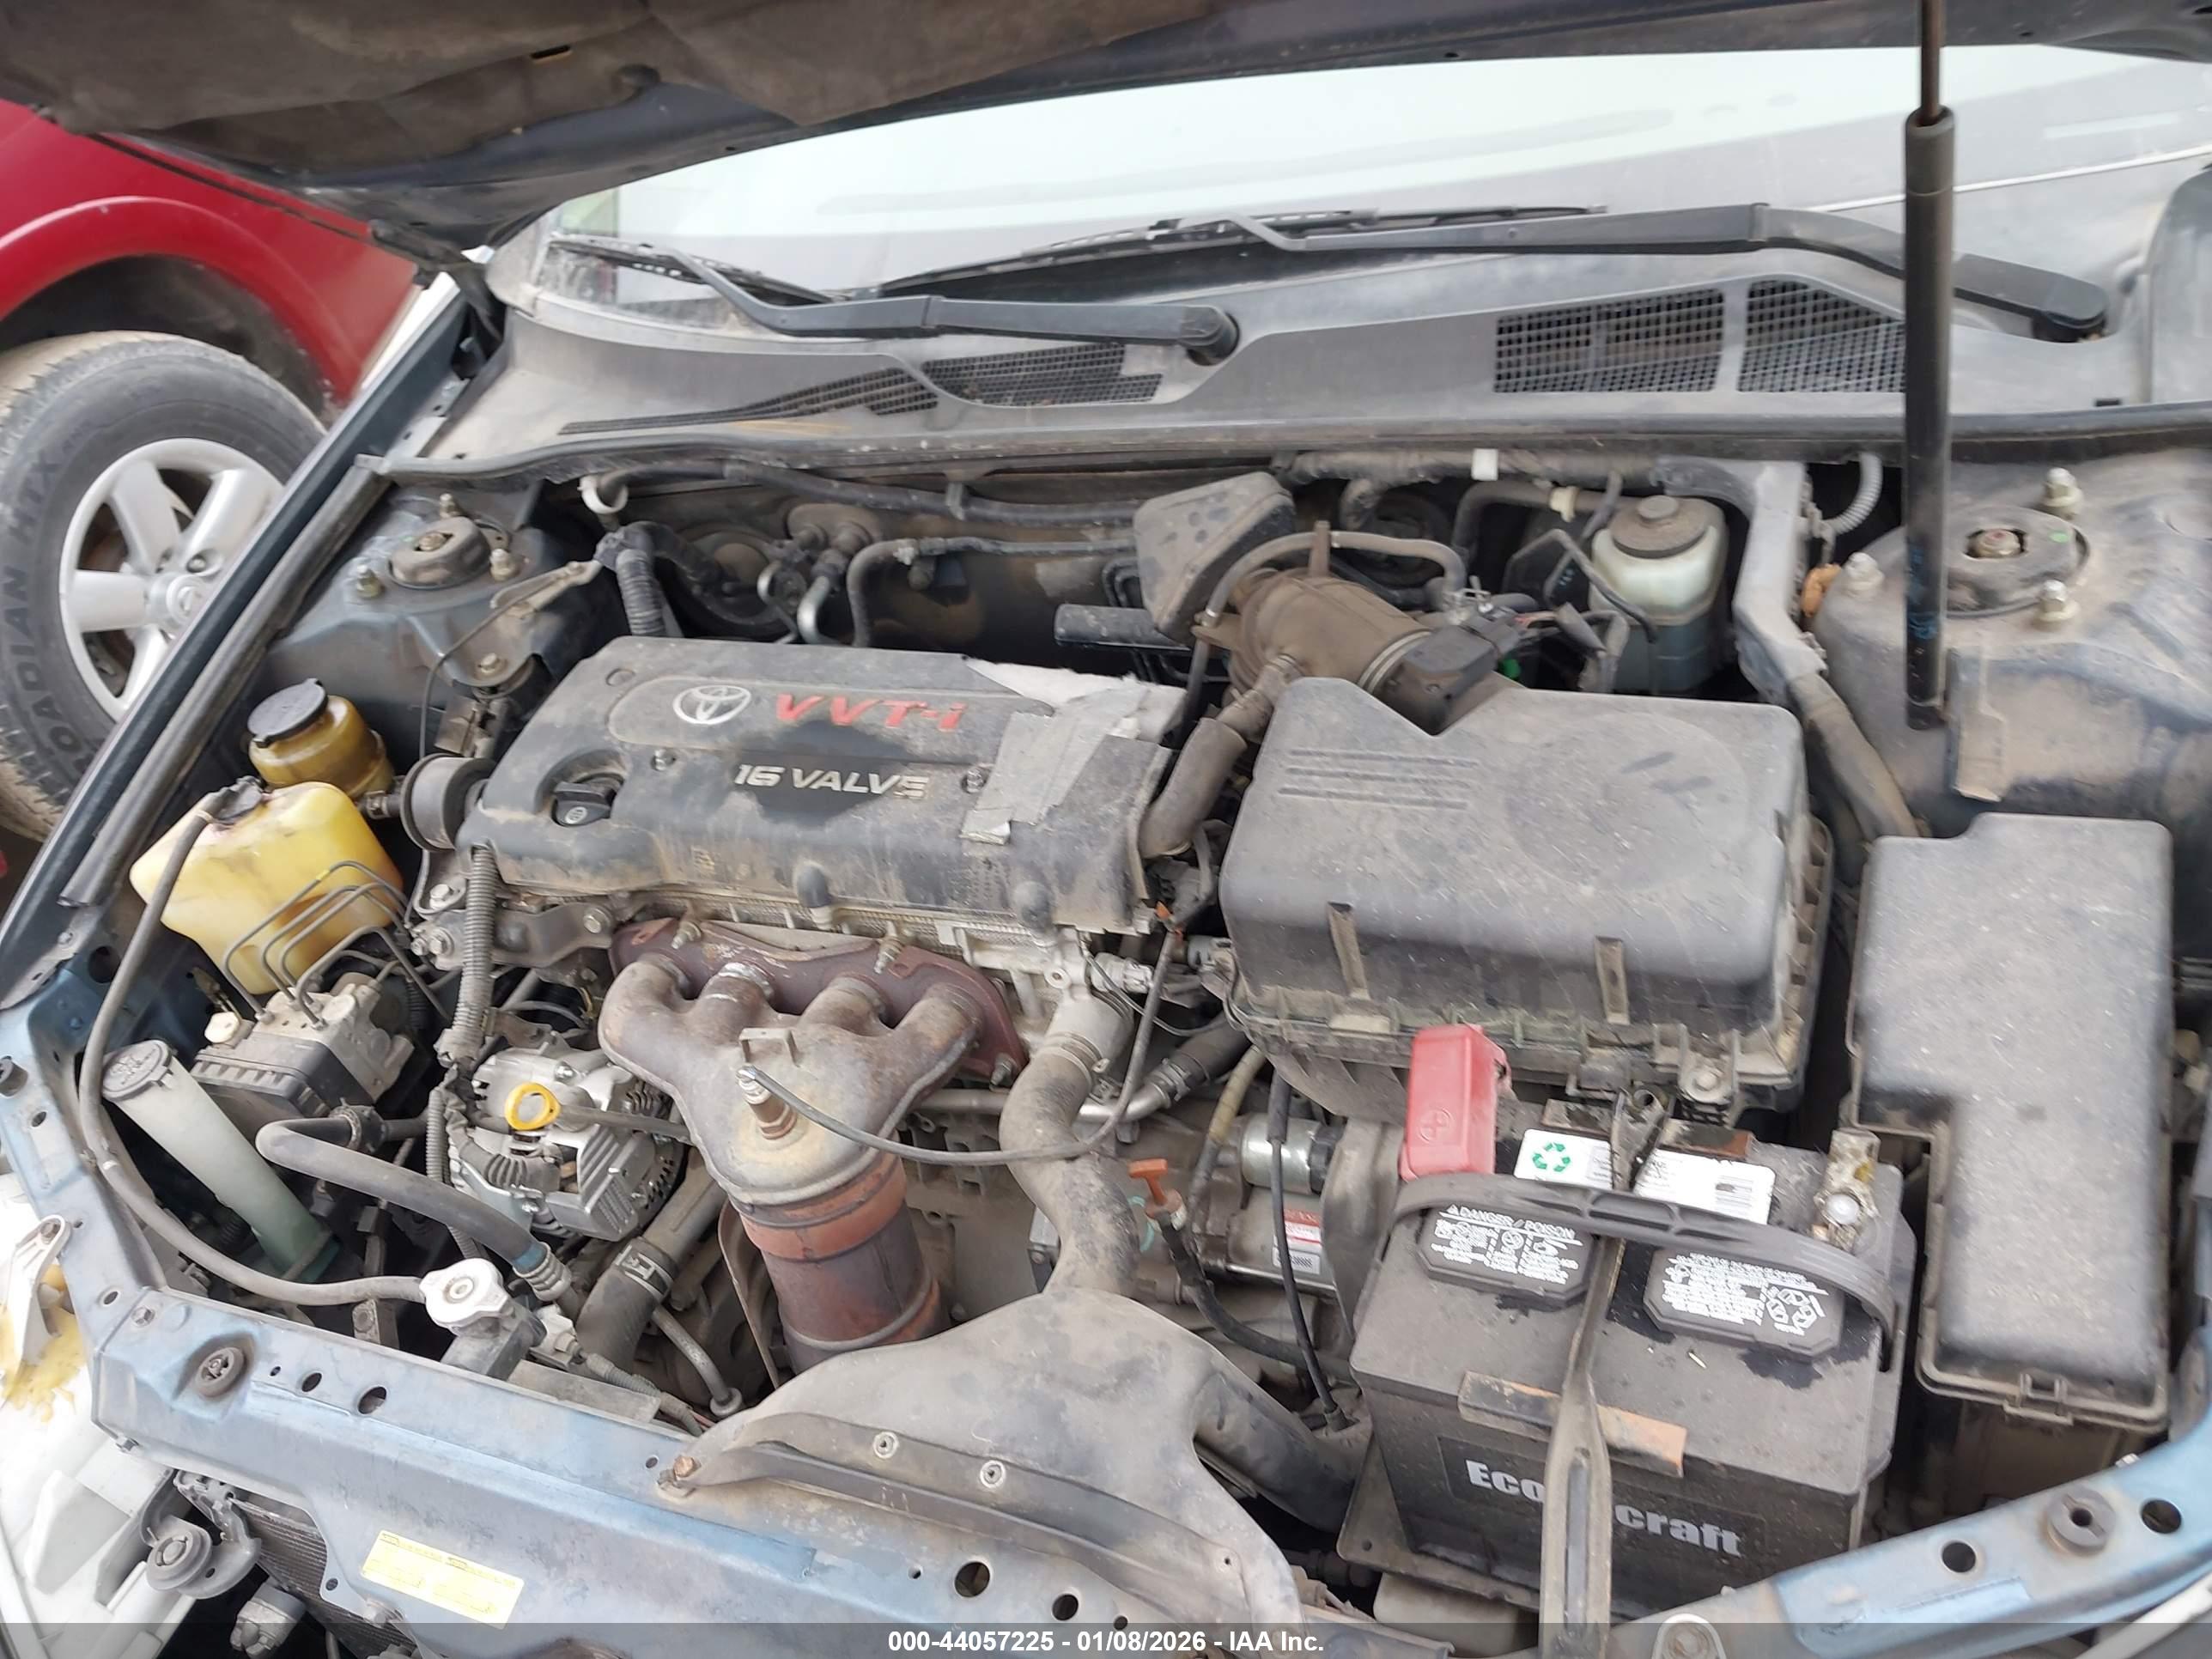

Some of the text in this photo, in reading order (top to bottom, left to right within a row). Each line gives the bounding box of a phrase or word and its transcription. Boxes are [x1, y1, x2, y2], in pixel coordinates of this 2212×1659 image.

[776, 693, 968, 732] VVT-i
[734, 765, 930, 799] 16 VALVE
[1465, 1459, 1741, 1558] Ecocraft
